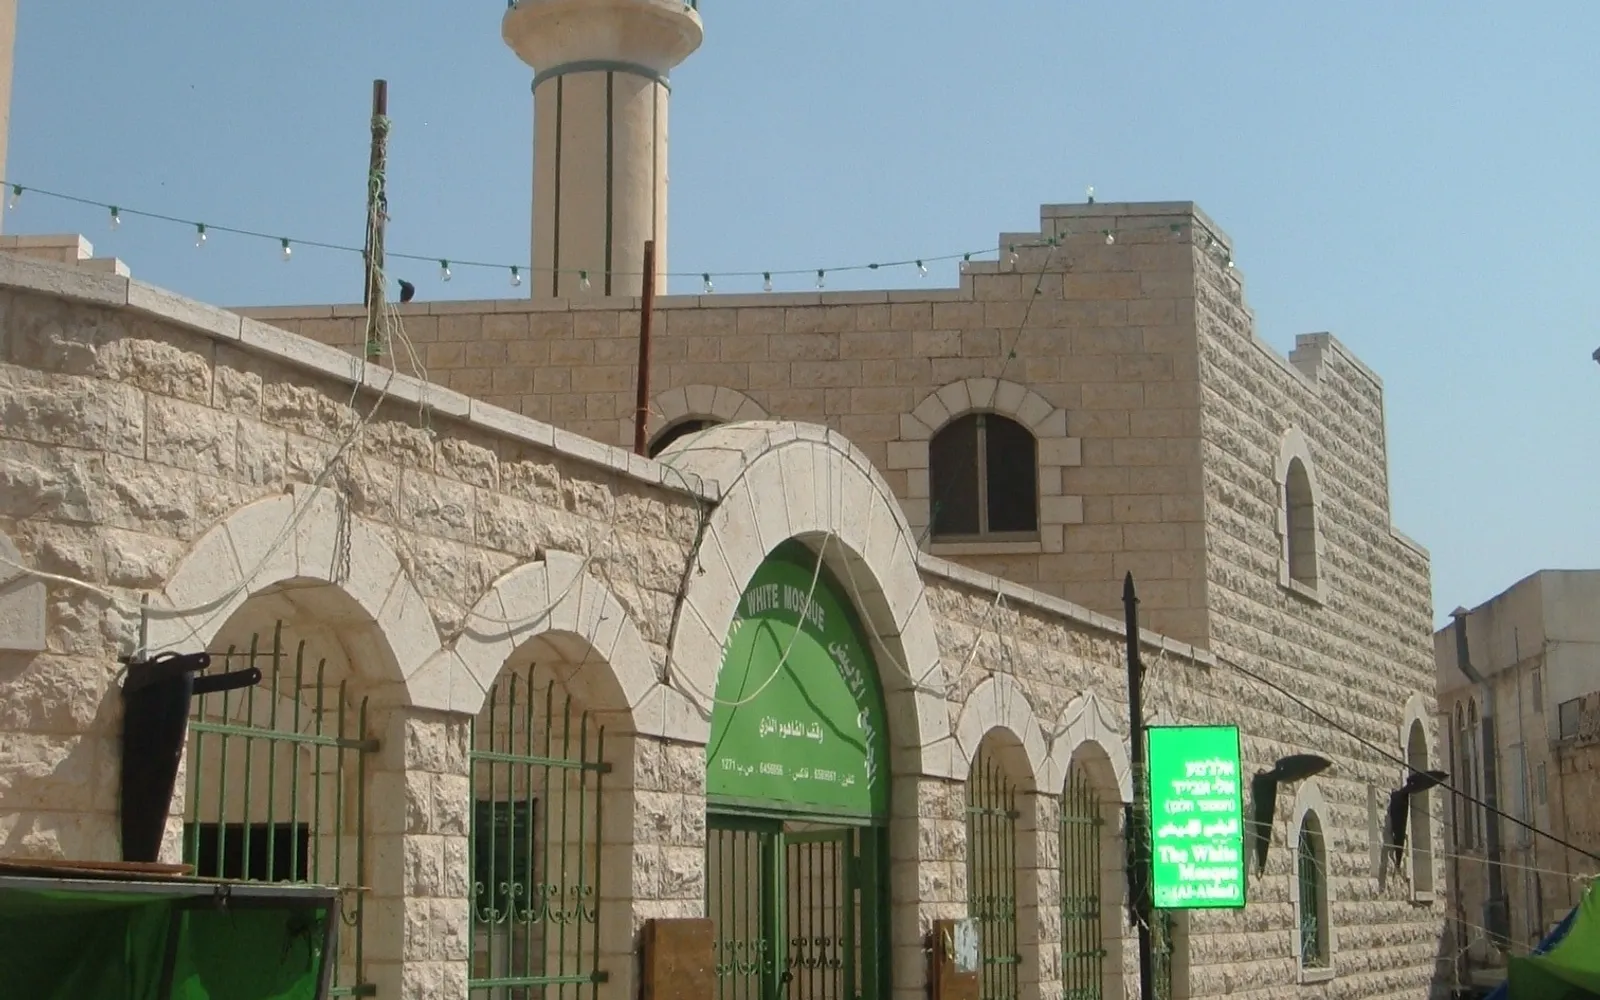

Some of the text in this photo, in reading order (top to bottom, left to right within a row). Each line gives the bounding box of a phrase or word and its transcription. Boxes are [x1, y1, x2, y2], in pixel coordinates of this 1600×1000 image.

[746, 583, 825, 632] WHITE MOSQUE
[1157, 844, 1238, 863] The White
[1178, 863, 1239, 883] Mosque
